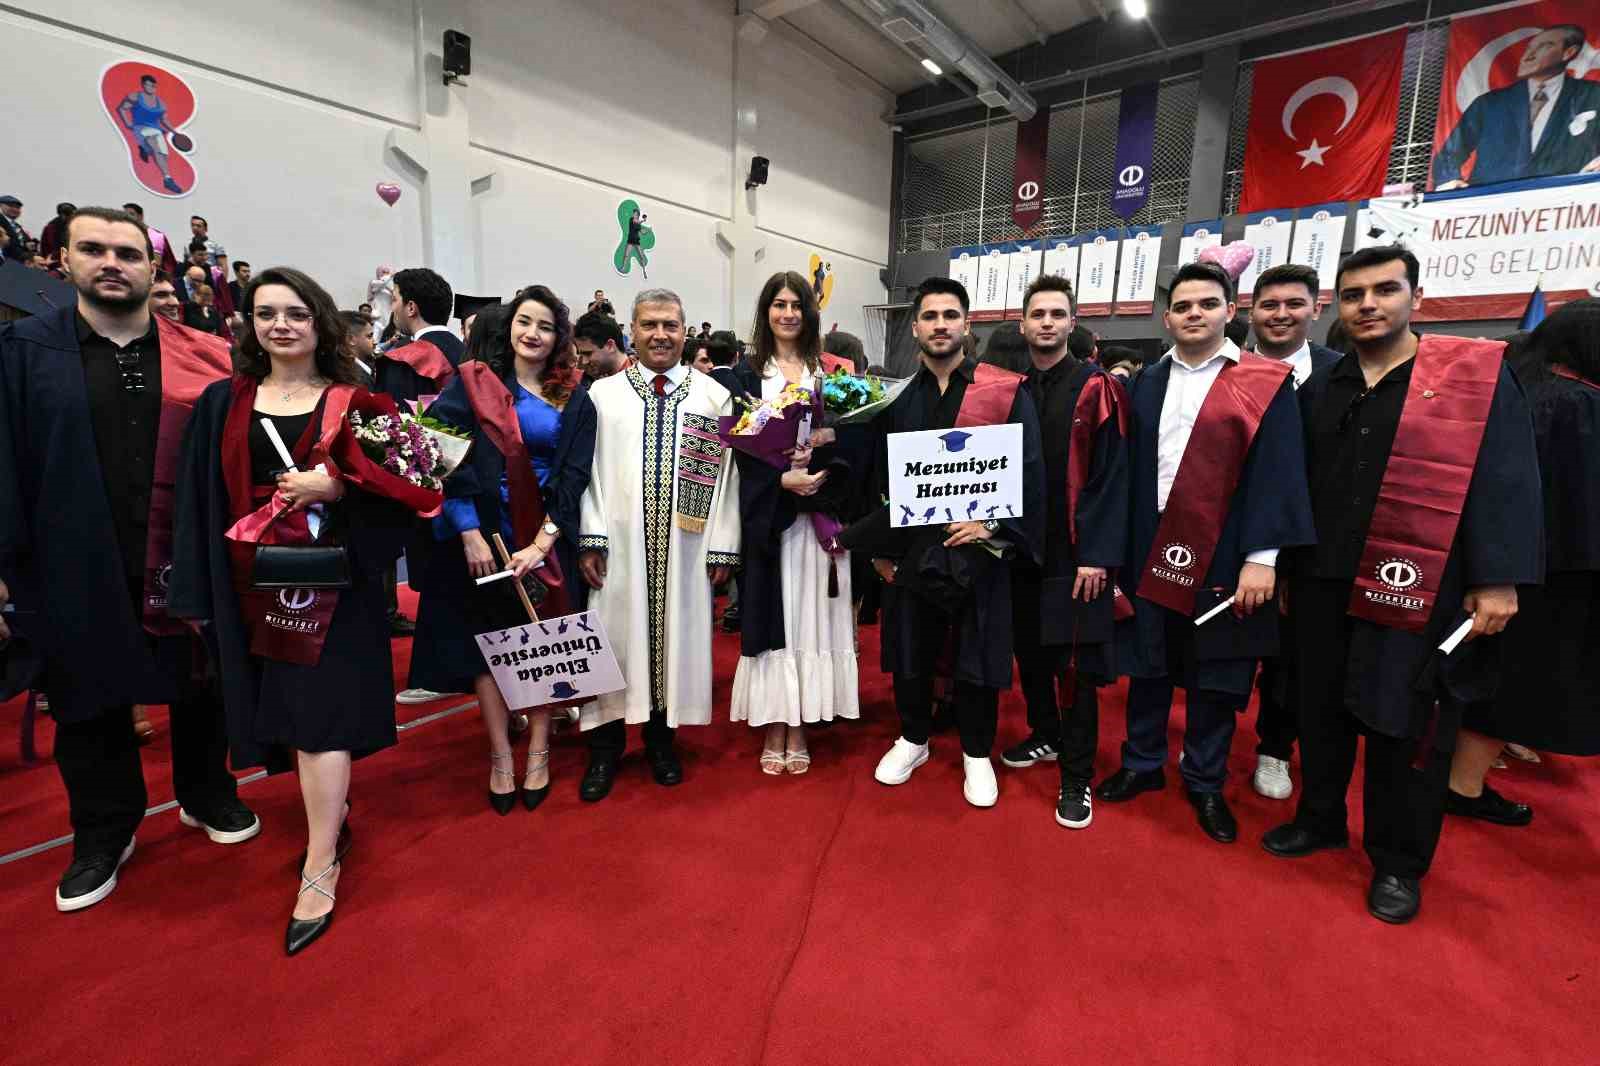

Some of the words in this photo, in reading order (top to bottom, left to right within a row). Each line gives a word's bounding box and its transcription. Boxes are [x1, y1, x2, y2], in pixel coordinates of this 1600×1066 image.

[1425, 253, 1476, 281] HOŞ
[904, 456, 1008, 477] Mezuniyet
[916, 481, 998, 499] Hatırası
[489, 635, 603, 666] Üniversite
[516, 658, 591, 682] Elveda
